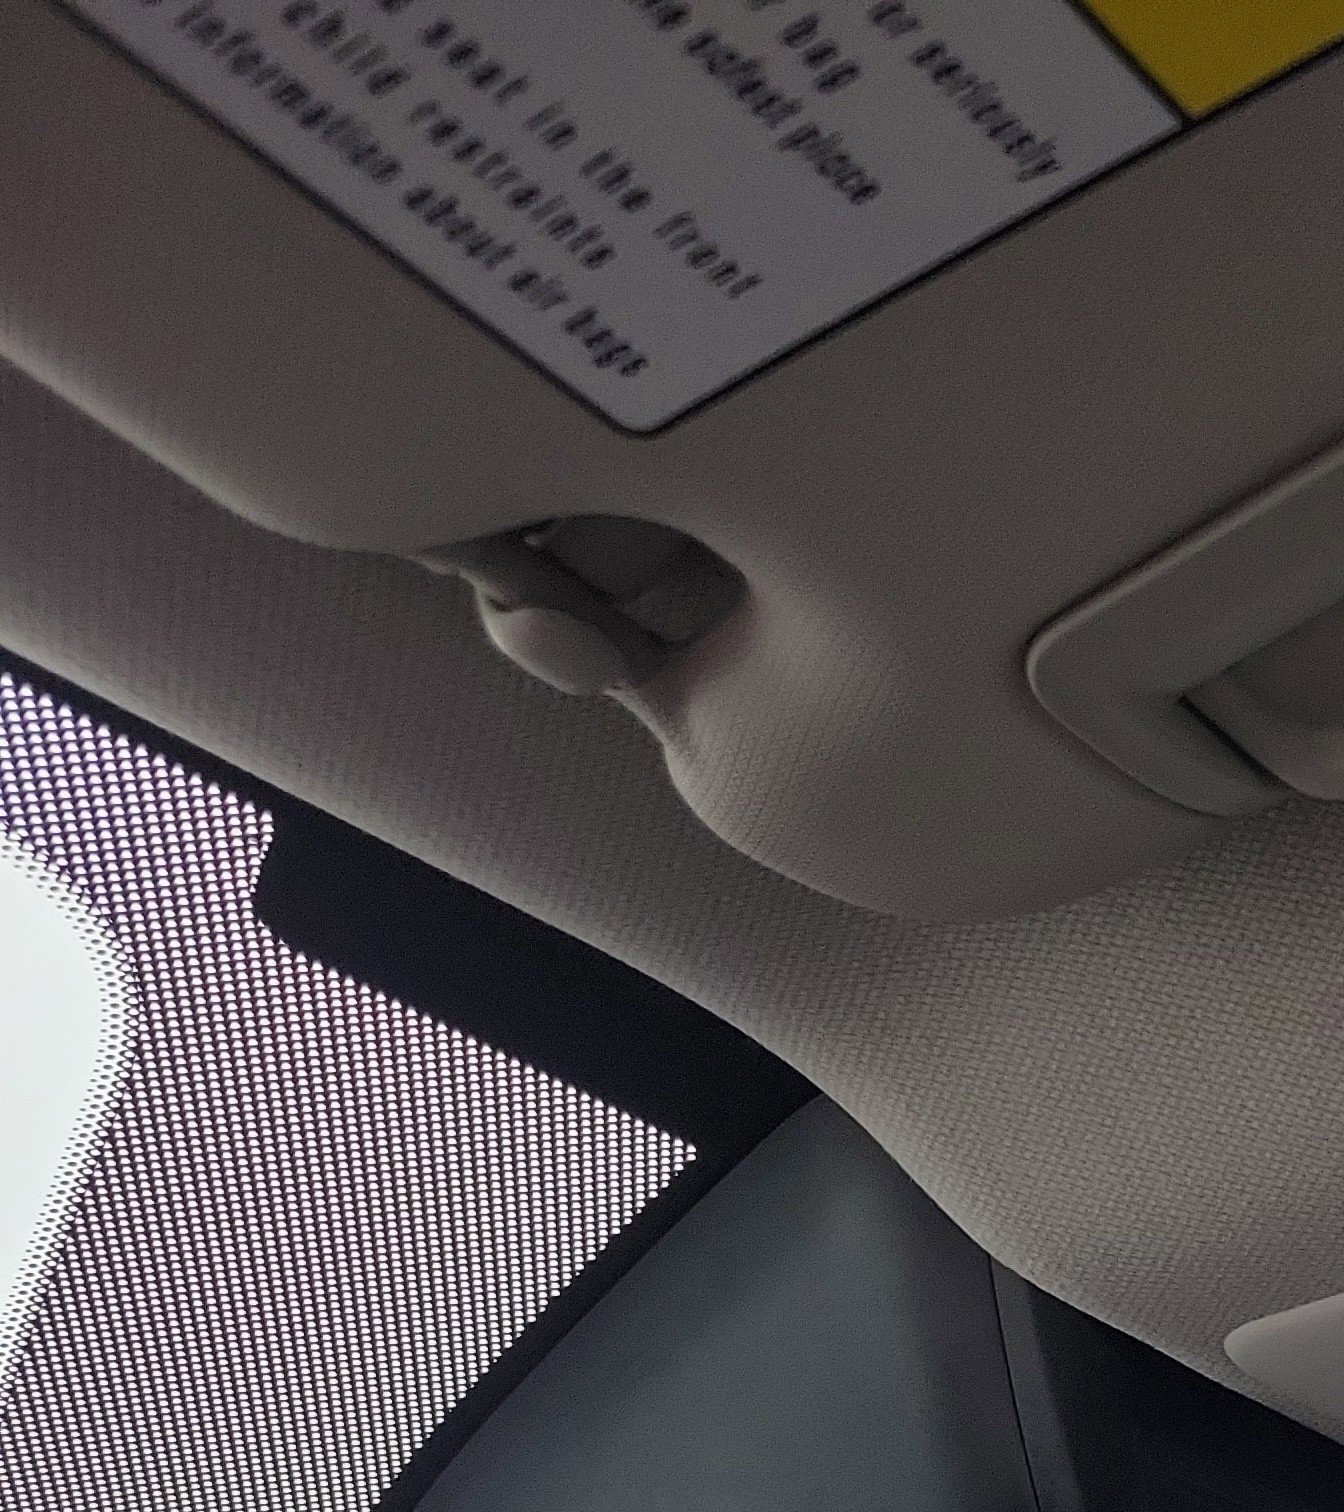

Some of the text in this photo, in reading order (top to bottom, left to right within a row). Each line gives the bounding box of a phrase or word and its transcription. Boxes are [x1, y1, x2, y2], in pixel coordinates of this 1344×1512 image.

[280, 0, 616, 270] child restraints
[422, 19, 763, 300] seat in the front
[682, 26, 881, 205] safest place
[779, 11, 860, 94] bag
[907, 39, 1063, 183] seriously
[174, 0, 651, 378] information about air bags
